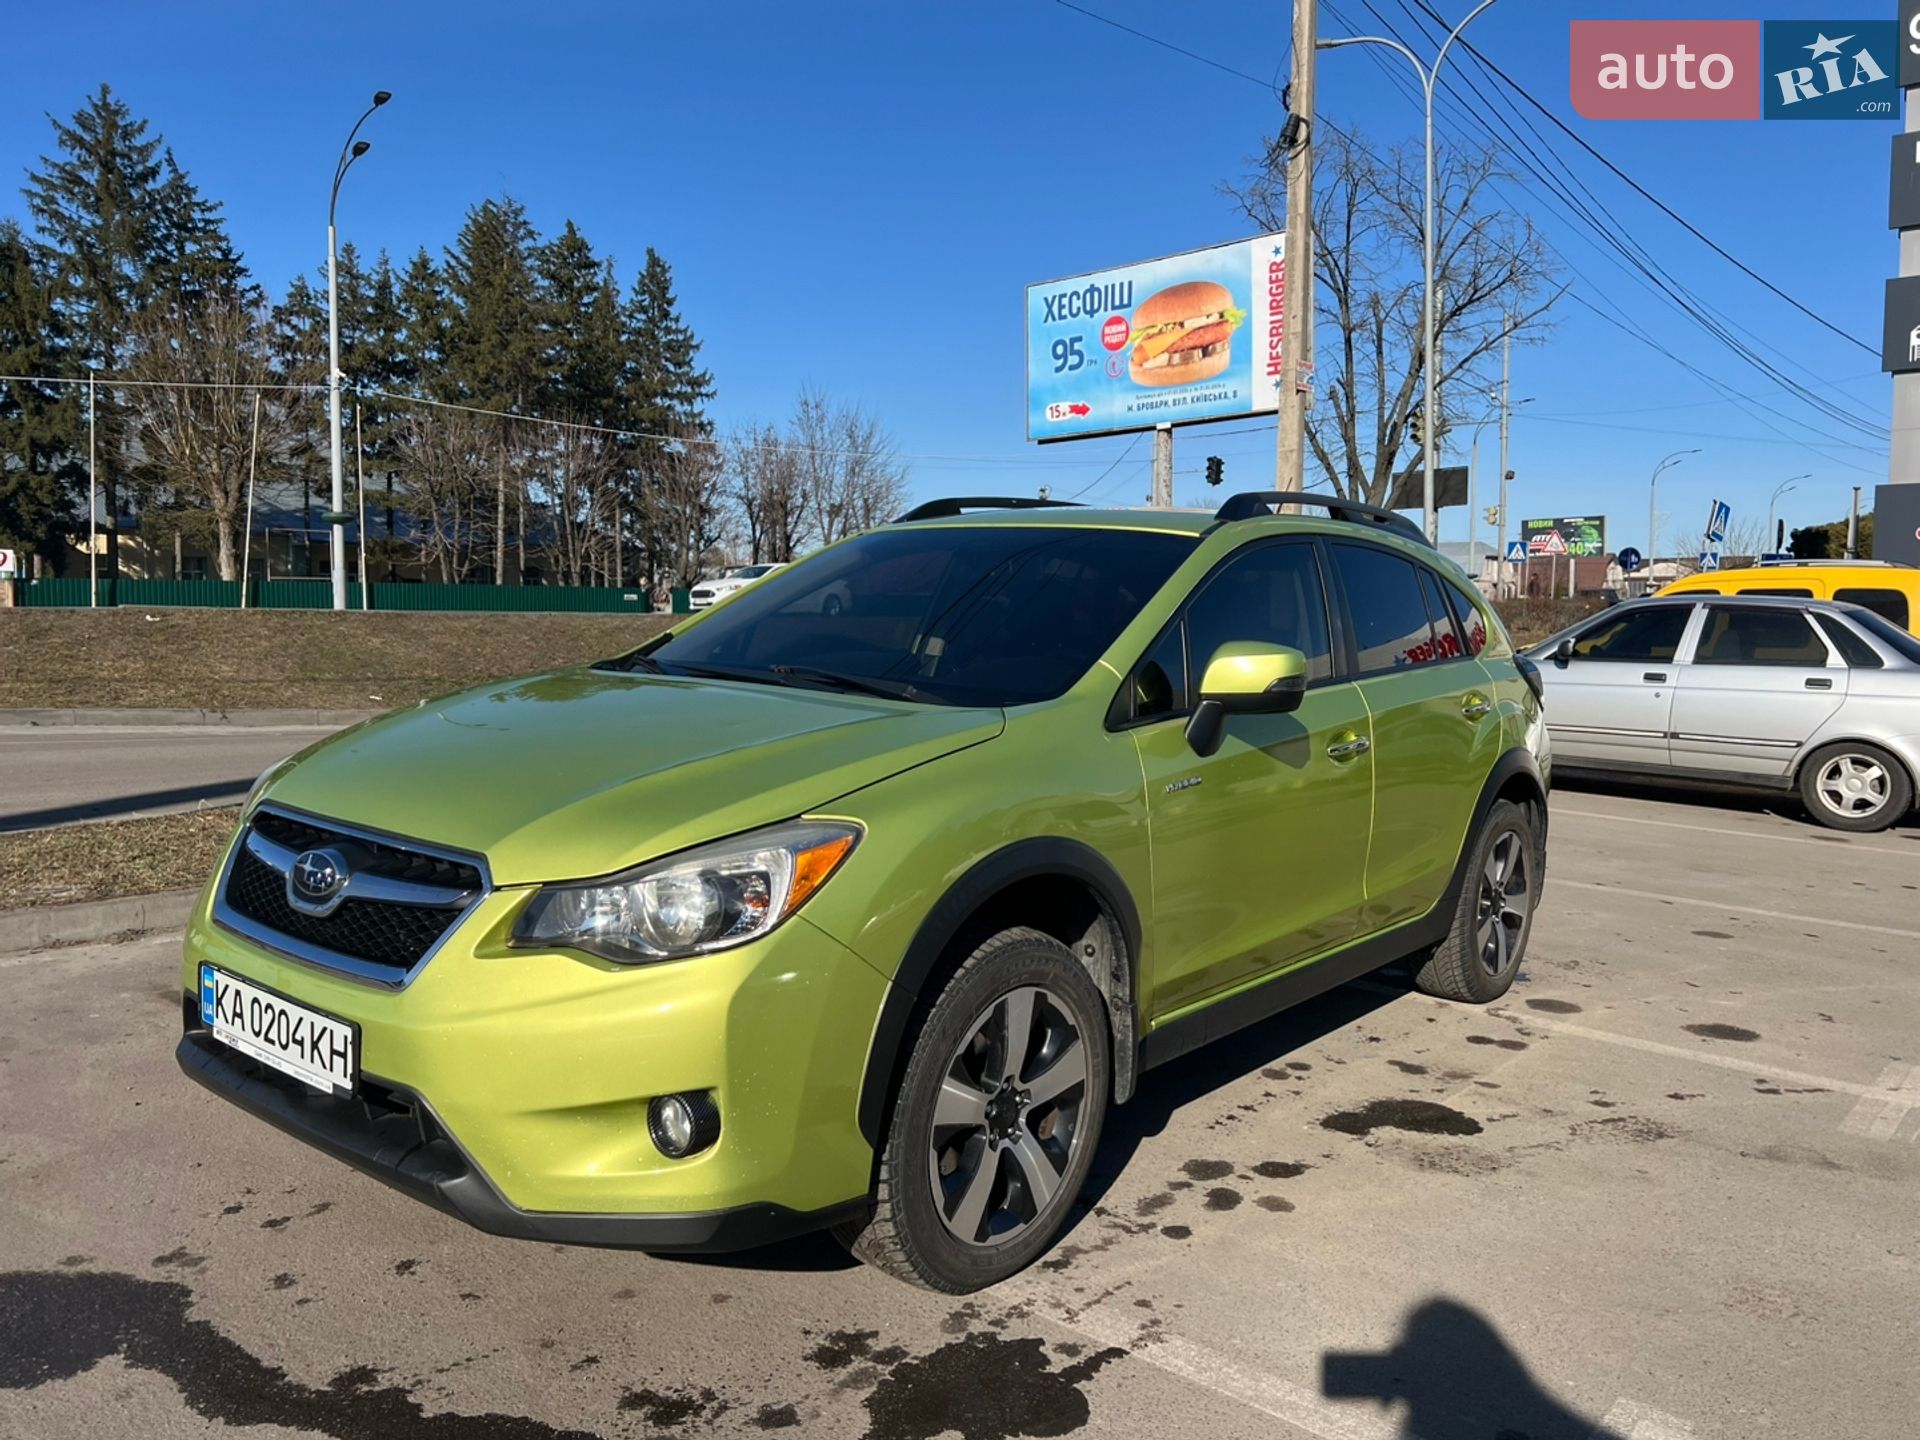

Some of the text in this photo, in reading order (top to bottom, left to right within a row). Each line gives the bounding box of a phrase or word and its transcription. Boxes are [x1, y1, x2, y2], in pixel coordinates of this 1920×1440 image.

[1043, 280, 1133, 323] ХЕСФІШ
[1266, 257, 1286, 377] HESBURGER
[1051, 336, 1085, 374] 95
